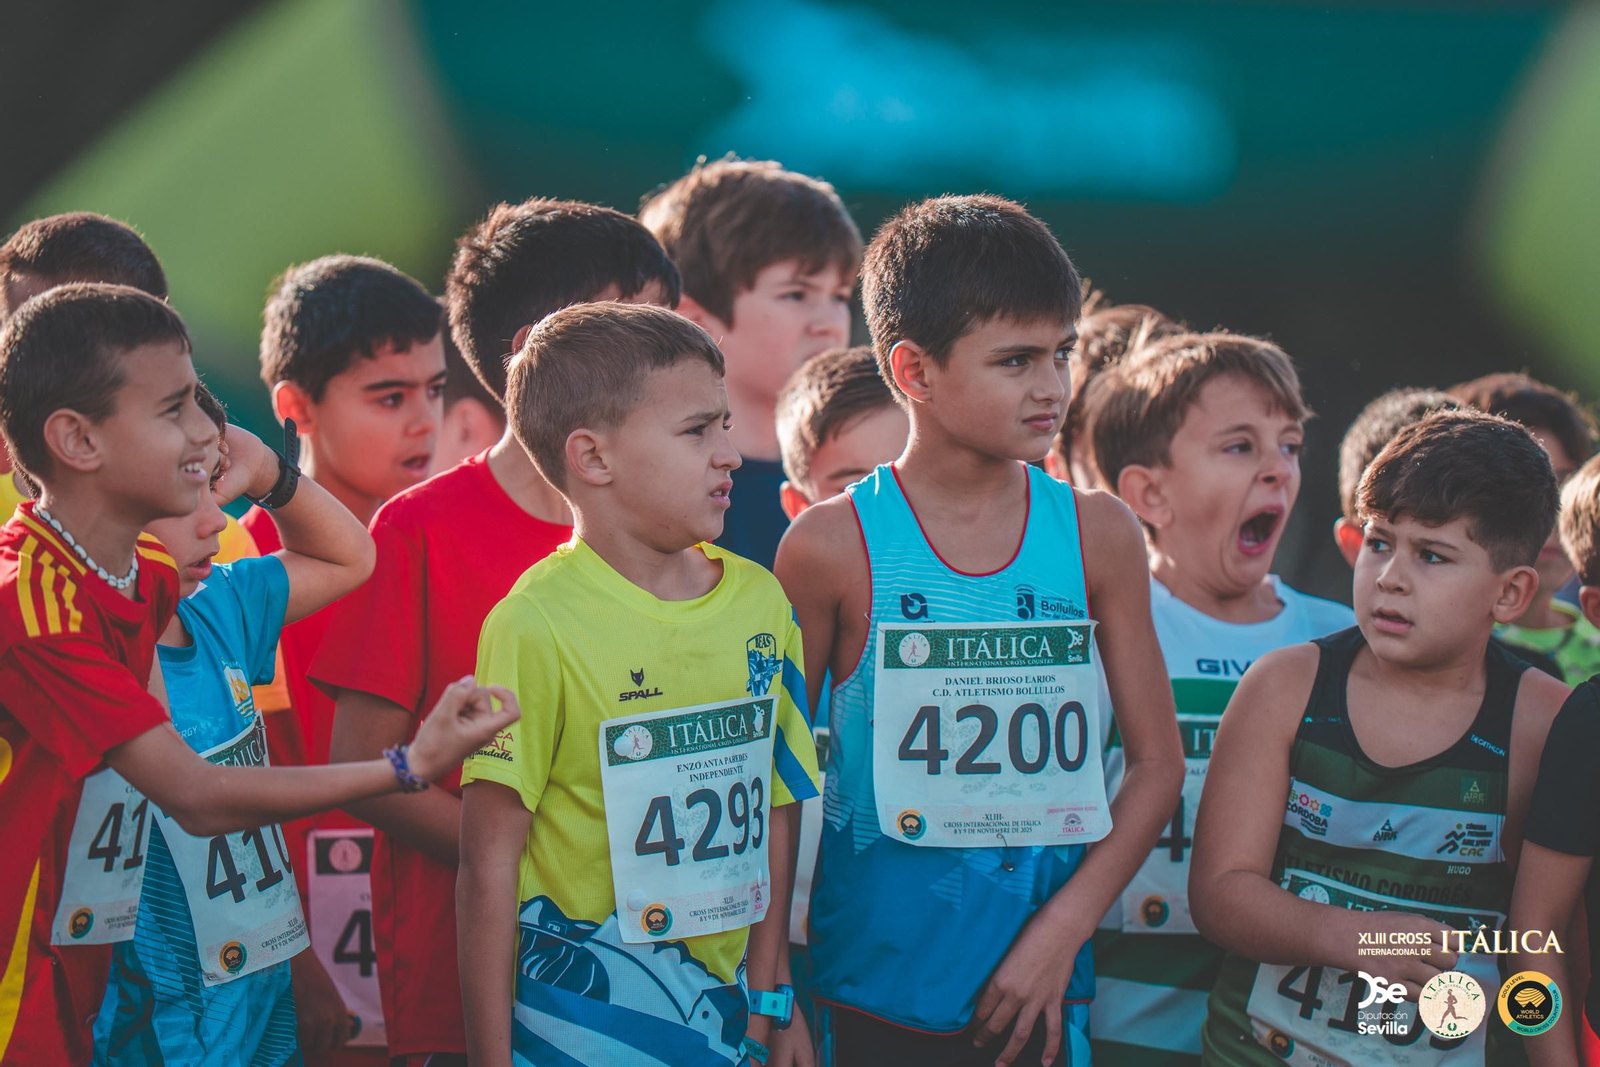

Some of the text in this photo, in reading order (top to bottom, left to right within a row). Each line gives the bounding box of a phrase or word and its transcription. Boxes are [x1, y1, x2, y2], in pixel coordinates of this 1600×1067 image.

[1041, 601, 1084, 618] Bollullos
[947, 631, 1054, 660] ITÁLICA
[945, 674, 1056, 686] DANIEL BRIOSO LARIOS
[618, 687, 664, 702] SPALL
[932, 686, 1065, 697] C.D. ATLETISMO BOLLULLOS
[668, 714, 748, 748] ITÁLICA
[898, 700, 1088, 776] 4200
[672, 742, 716, 754] INTERNATIONAL
[1470, 734, 1506, 757] DECATHLON
[676, 752, 748, 773] ENZO ANTA PAREDES
[689, 765, 744, 782] INDEPENDIENTE
[634, 776, 764, 866] 4293
[1286, 802, 1328, 828] CÓRDOBA
[87, 798, 149, 873] 41
[1458, 846, 1485, 857] CAC
[1446, 865, 1472, 876] HUGO
[690, 909, 707, 918] CROSS
[332, 909, 377, 978] 4
